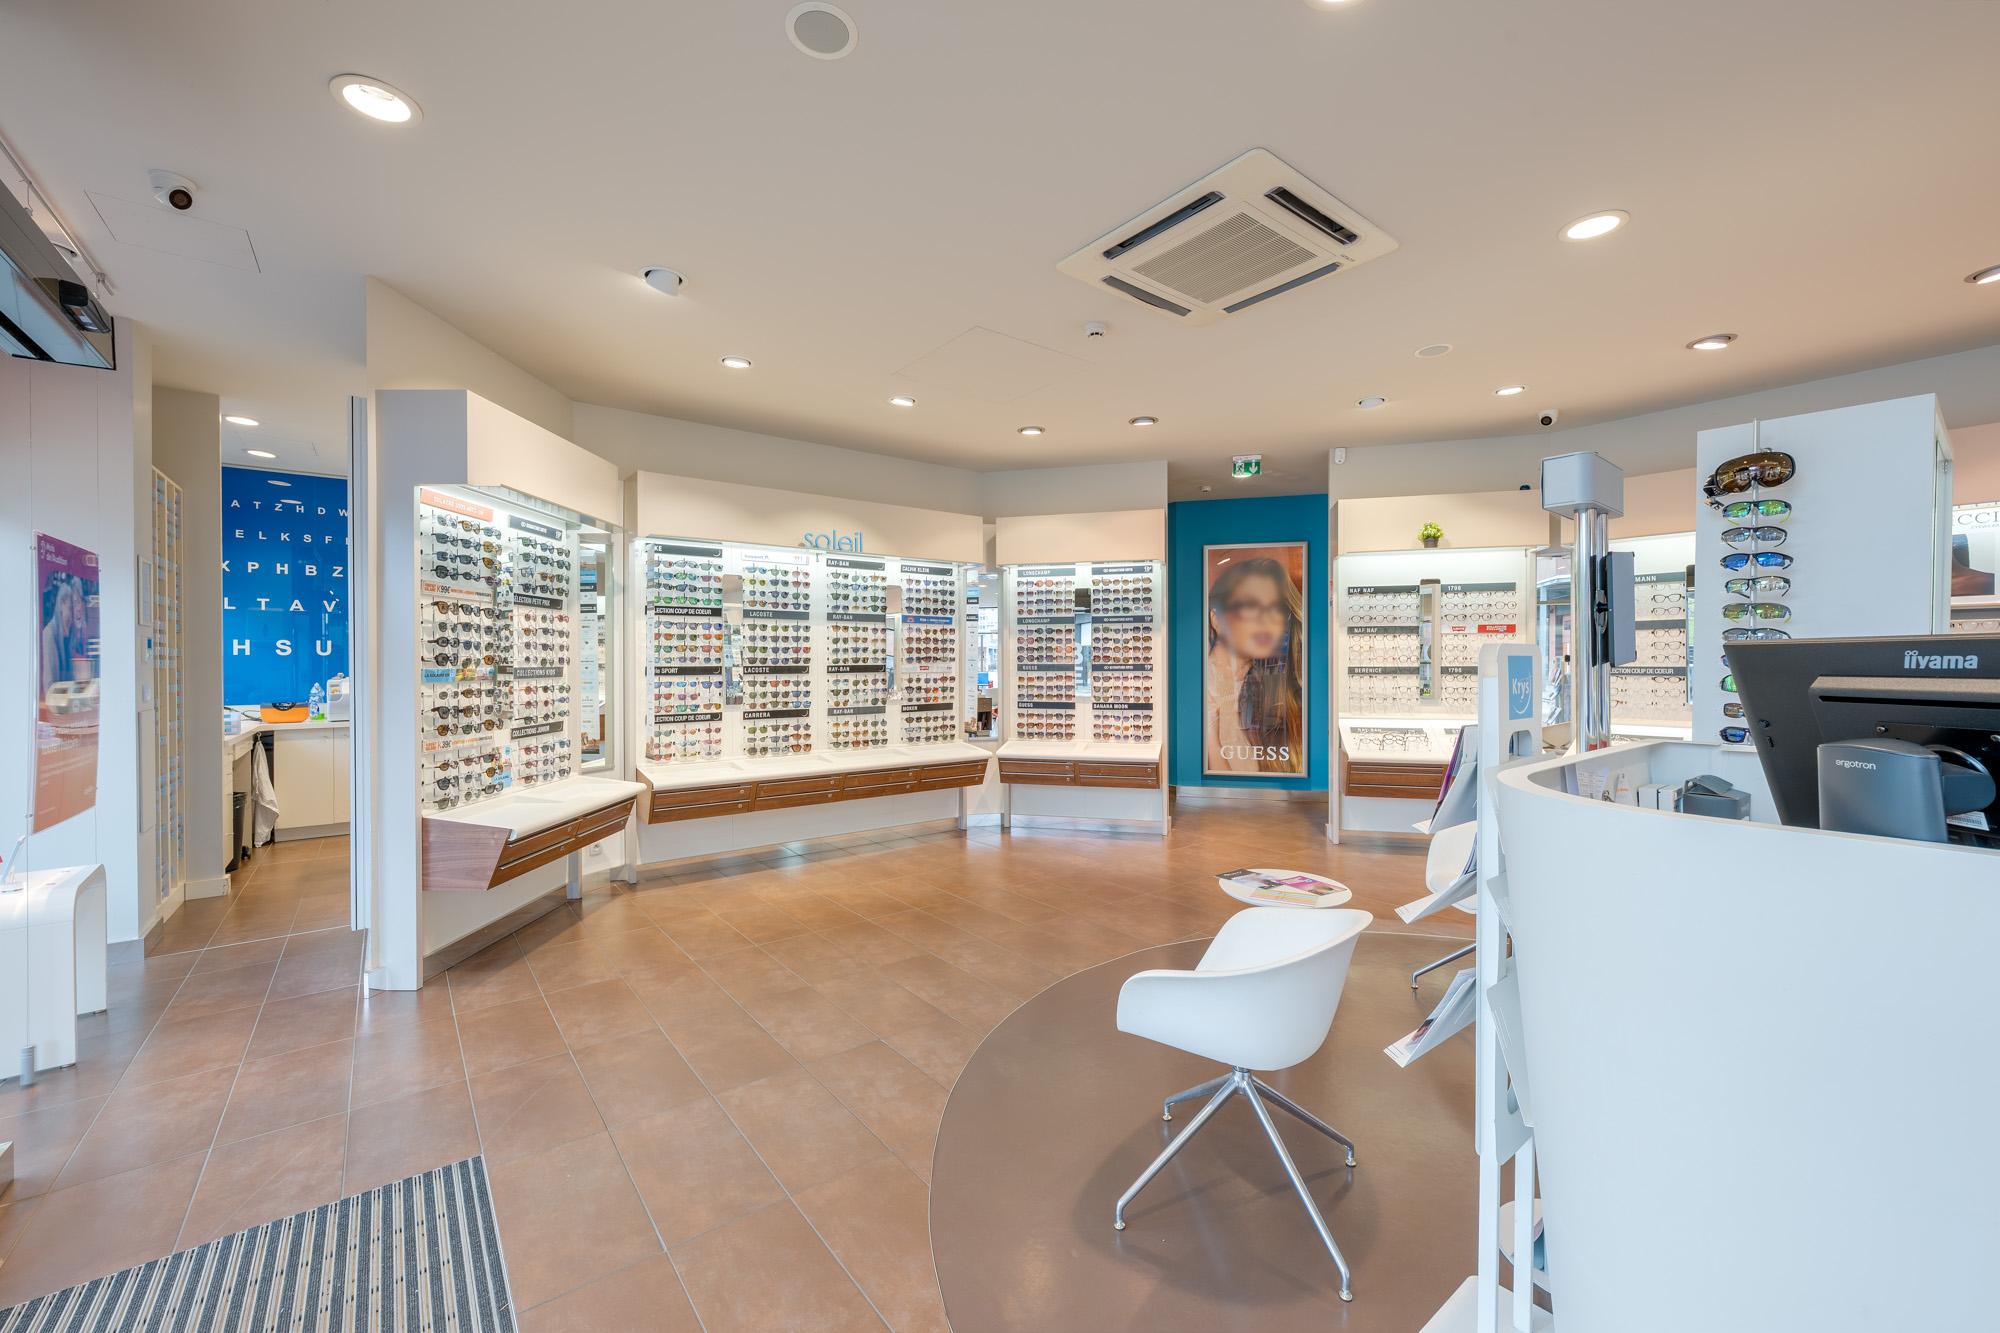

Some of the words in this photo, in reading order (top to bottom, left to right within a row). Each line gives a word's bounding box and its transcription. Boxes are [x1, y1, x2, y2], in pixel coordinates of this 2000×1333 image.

[1958, 511, 2000, 525] CCI
[235, 530, 244, 538] E
[258, 531, 267, 539] L
[280, 532, 290, 541] K
[303, 534, 312, 543] S
[804, 529, 863, 553] soleil
[248, 562, 259, 573] P
[276, 563, 289, 575] H
[305, 564, 318, 576] B
[332, 566, 343, 577] Z
[224, 597, 236, 610] L
[256, 598, 270, 611] T
[289, 600, 305, 611] A
[232, 639, 250, 656] H
[276, 639, 292, 656] S
[316, 640, 332, 656] U
[1904, 650, 1978, 669] iiyama
[1513, 678, 1529, 699] Krys
[1220, 746, 1289, 761] GUESS
[1835, 760, 1876, 770] ergotron
